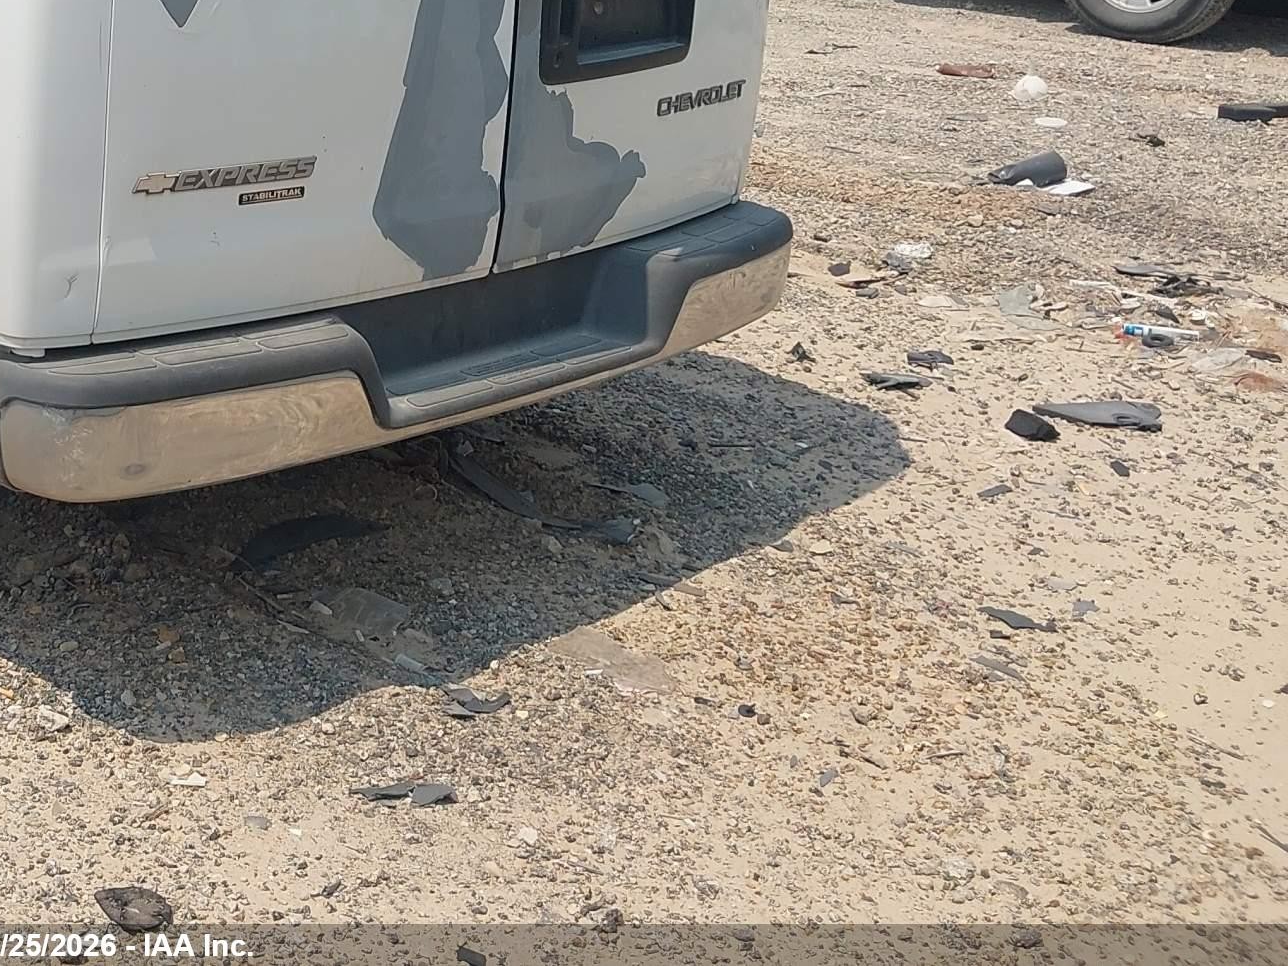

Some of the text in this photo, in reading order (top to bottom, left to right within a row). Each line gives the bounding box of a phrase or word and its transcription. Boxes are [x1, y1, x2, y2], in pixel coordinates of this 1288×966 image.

[657, 79, 746, 117] CHEVROLET
[175, 155, 317, 191] EXPRESS
[242, 187, 301, 202] STABILITRAK
